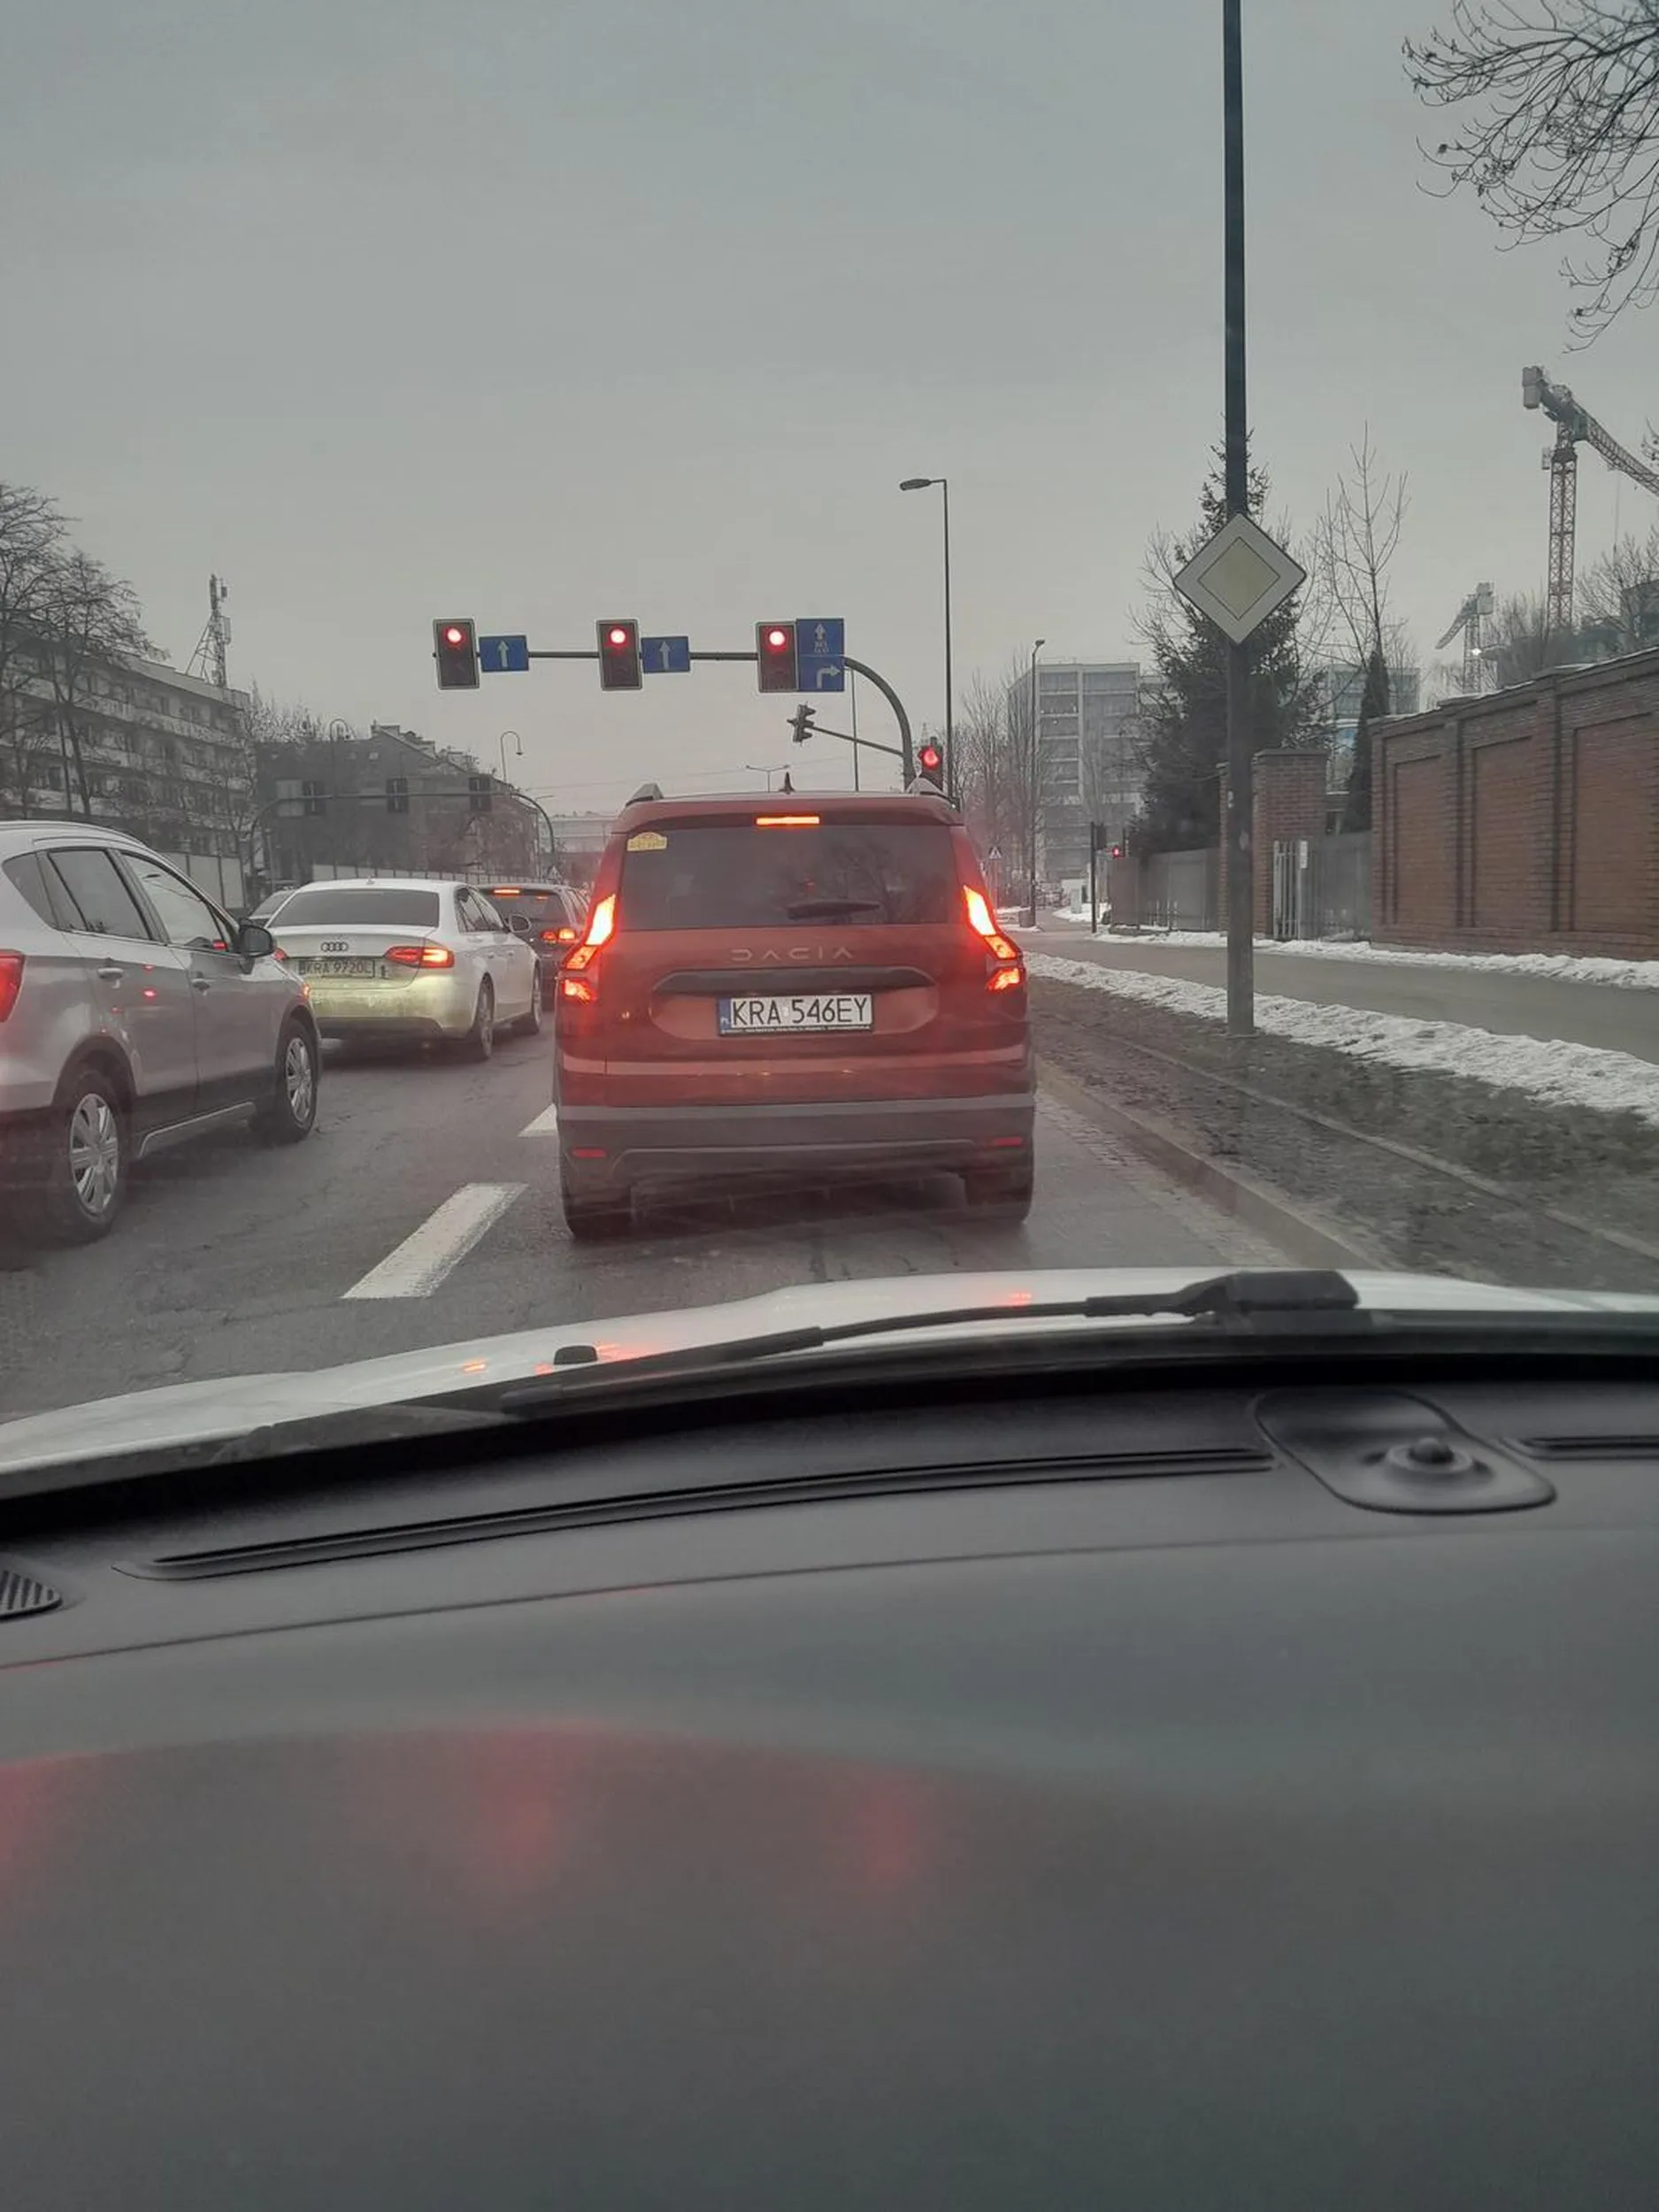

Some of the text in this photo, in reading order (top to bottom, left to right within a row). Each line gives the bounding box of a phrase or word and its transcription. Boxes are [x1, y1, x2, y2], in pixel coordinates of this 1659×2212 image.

[730, 946, 855, 962] DACIA
[733, 997, 867, 1026] KRA 546EY
